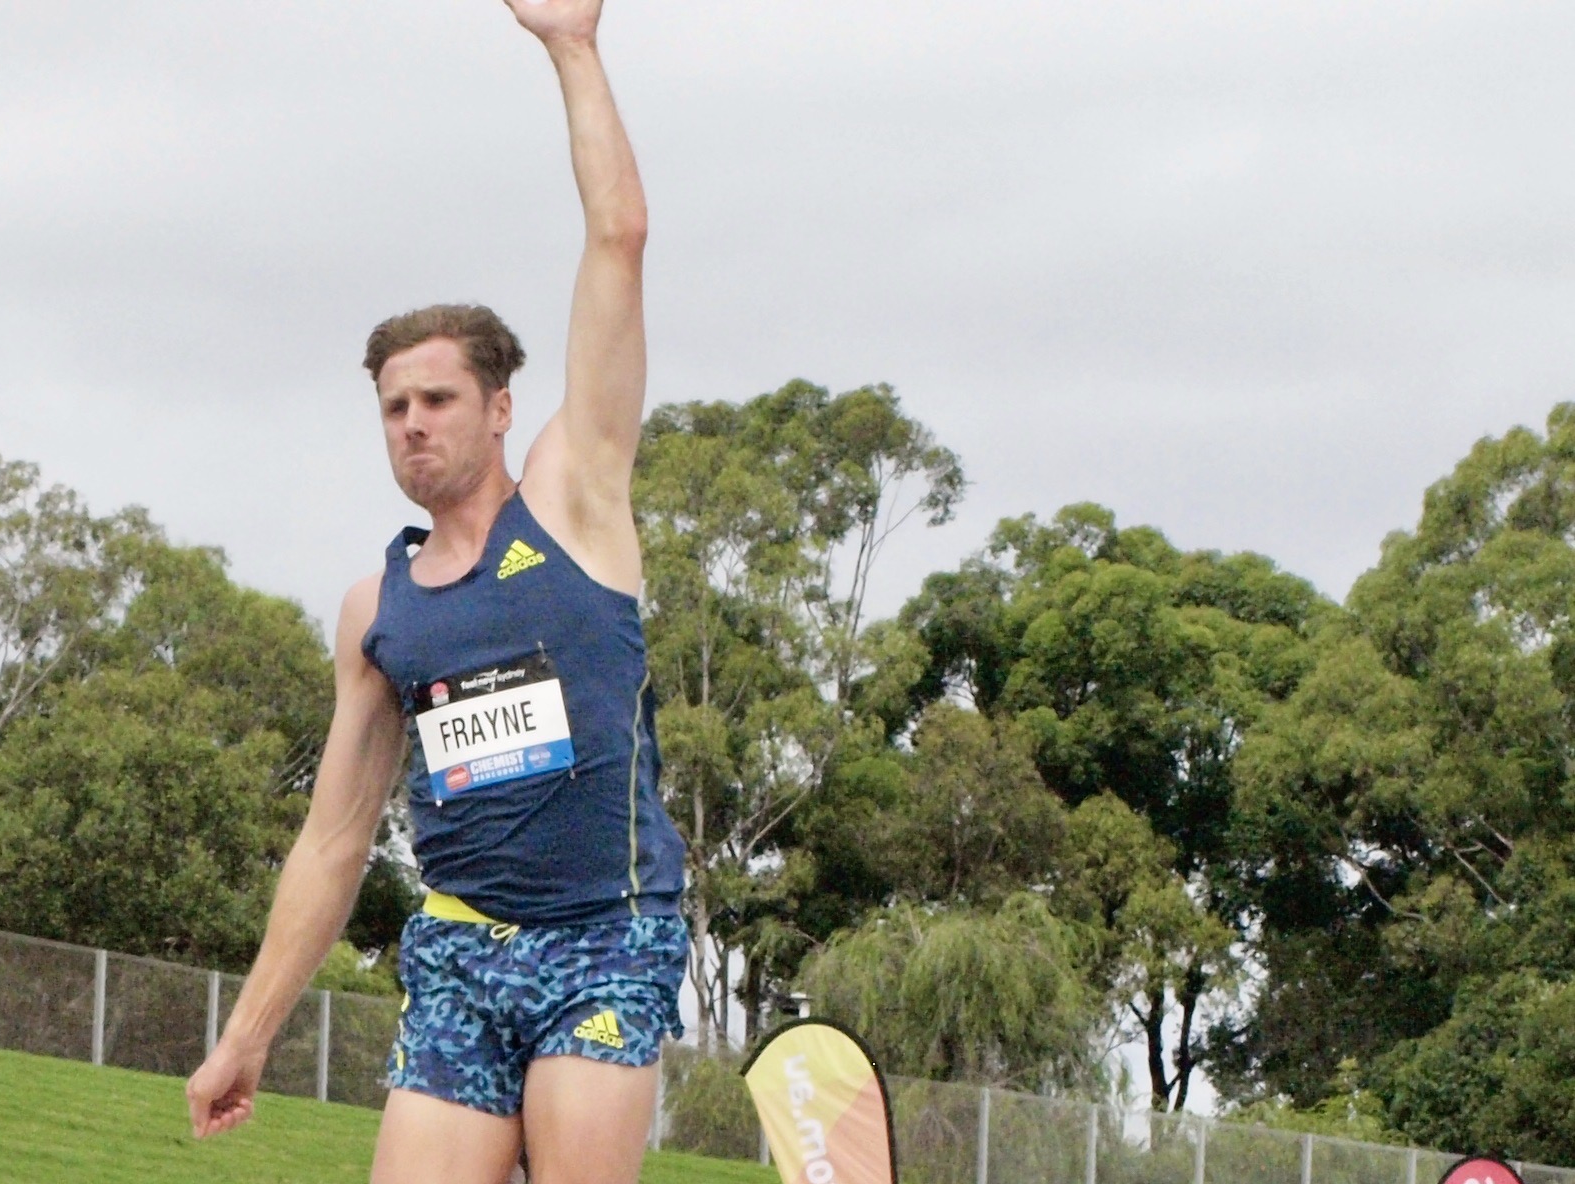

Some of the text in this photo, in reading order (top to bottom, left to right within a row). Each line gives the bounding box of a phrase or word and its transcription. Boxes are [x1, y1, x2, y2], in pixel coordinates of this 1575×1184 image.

[496, 552, 546, 579] adidas
[439, 700, 537, 753] FRAYNE
[469, 749, 525, 775] CHEMIST
[573, 1025, 624, 1050] adidas
